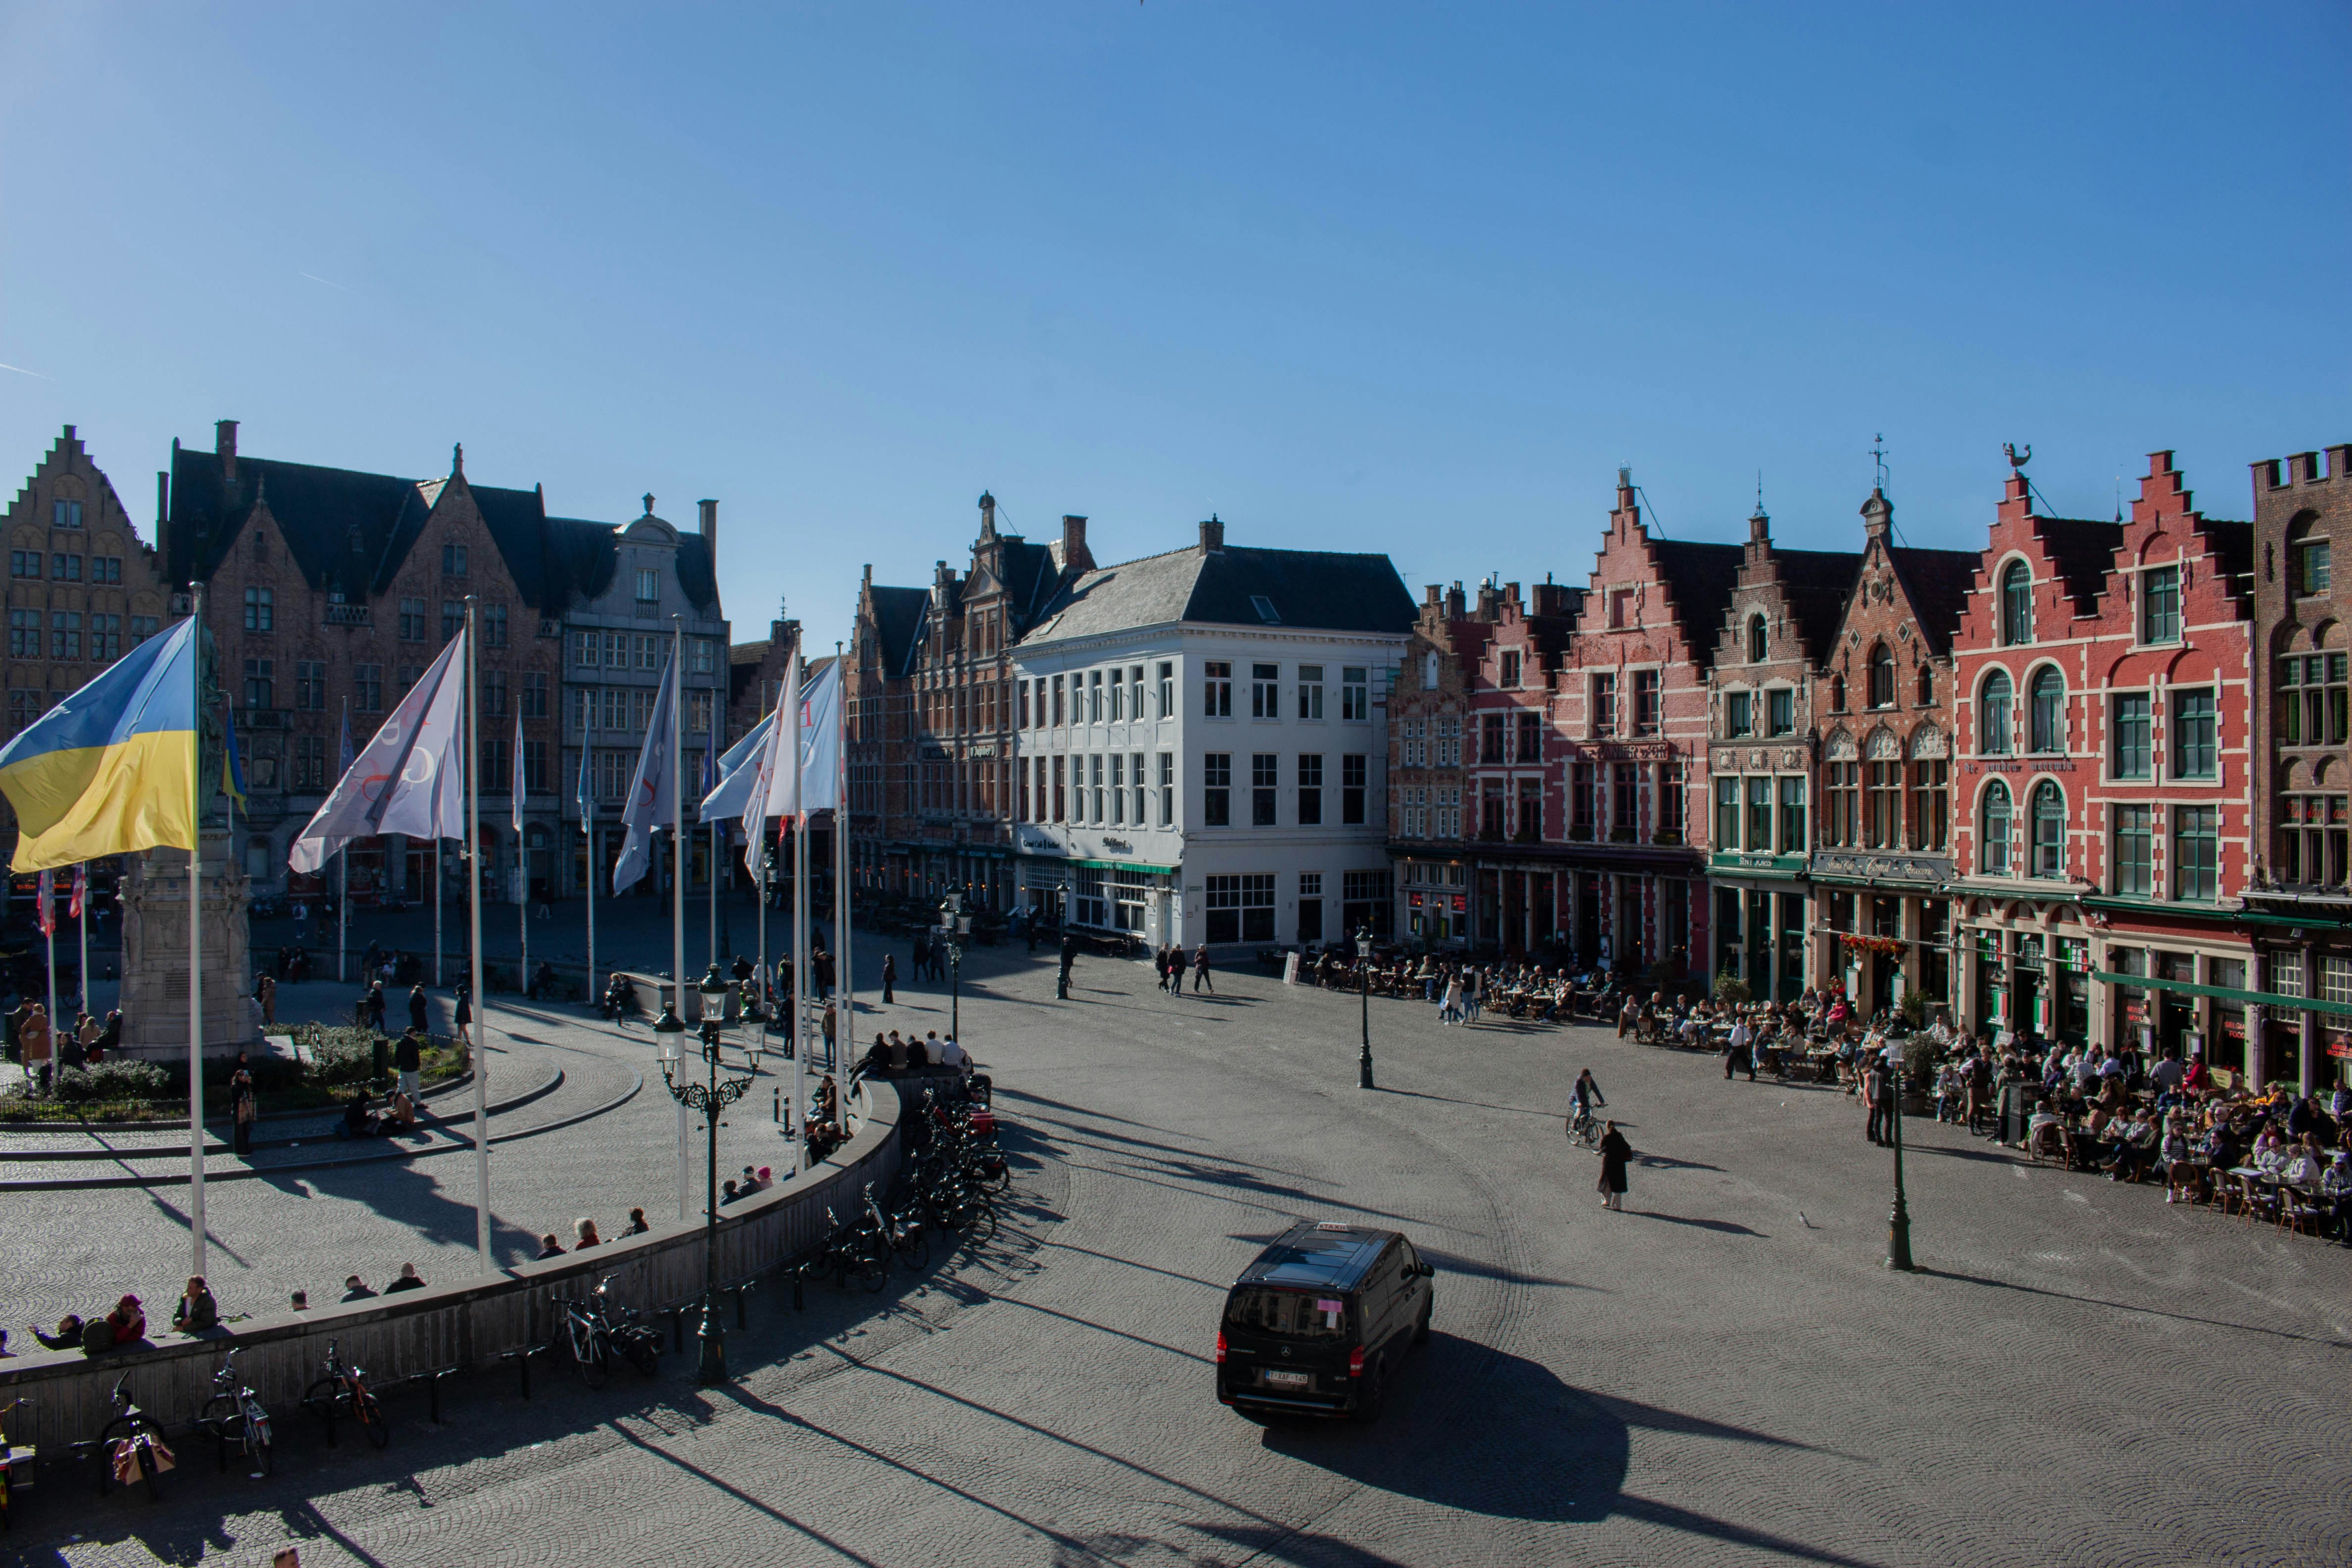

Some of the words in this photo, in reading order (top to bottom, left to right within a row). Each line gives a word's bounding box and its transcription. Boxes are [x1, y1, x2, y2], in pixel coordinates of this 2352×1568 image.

[1598, 744, 1637, 759] PANIER
[1739, 857, 1753, 866] SINT
[1754, 858, 1773, 867] JORIS
[1865, 857, 1891, 874] Central
[1902, 864, 1934, 876] Brasserie
